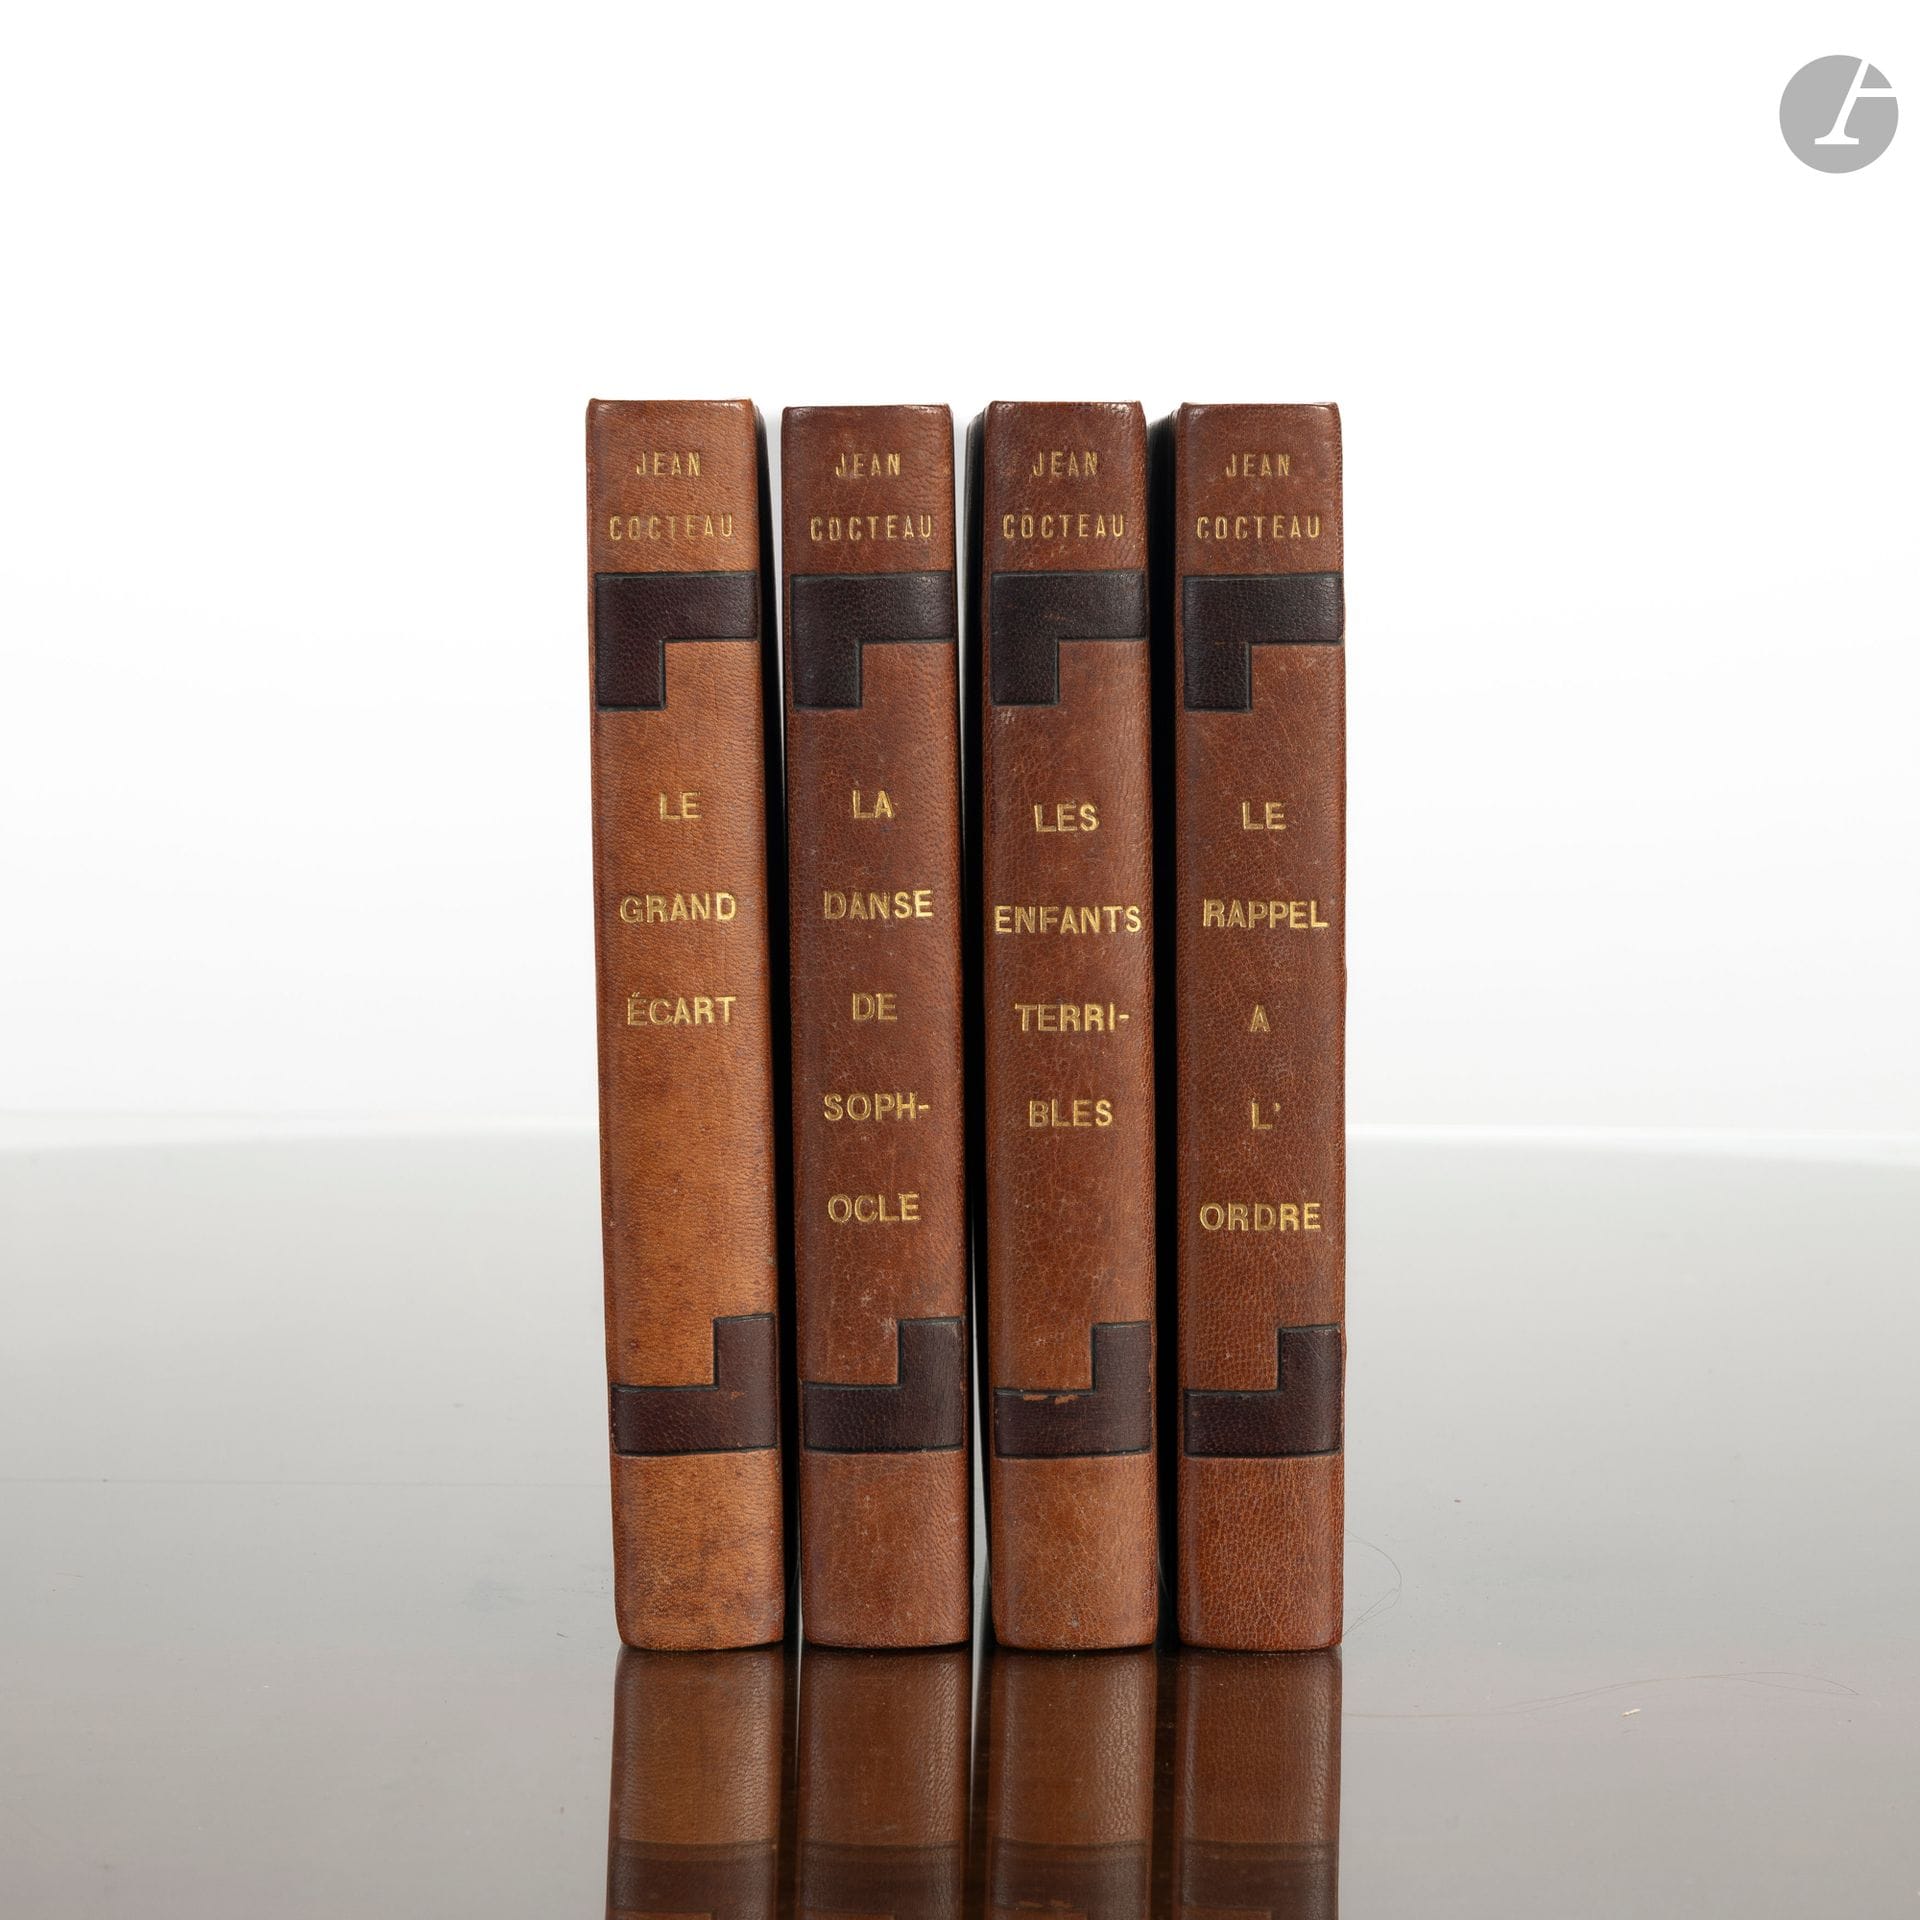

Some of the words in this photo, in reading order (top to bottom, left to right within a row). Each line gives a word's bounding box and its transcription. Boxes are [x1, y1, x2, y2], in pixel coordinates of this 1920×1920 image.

[637, 452, 701, 477] JEAN
[836, 453, 900, 478] JEAN
[1033, 452, 1097, 477] JEAN
[1226, 454, 1290, 476] JEAN
[609, 515, 733, 541] COCTEAU
[811, 515, 931, 541] COCTEAU
[1003, 516, 1123, 539] COCTEAU
[1197, 516, 1319, 539] COCTEAU
[660, 793, 699, 820] LE
[853, 790, 894, 818] LA
[1034, 803, 1099, 832] LES
[1242, 802, 1286, 830] LE
[620, 892, 736, 924] GRAND
[825, 890, 934, 919] DANSE
[1203, 899, 1329, 929] RAPPEL
[995, 906, 1143, 933] ENFANTS
[627, 992, 737, 1026] ÉCART
[853, 993, 897, 1020] DE
[1015, 1002, 1129, 1032] TERRI-
[1250, 1005, 1270, 1032] A
[824, 1092, 930, 1121] SOPH-
[1030, 1099, 1112, 1127] BLES
[828, 1193, 921, 1223] OCLE
[1200, 1203, 1321, 1232] ORDRE
